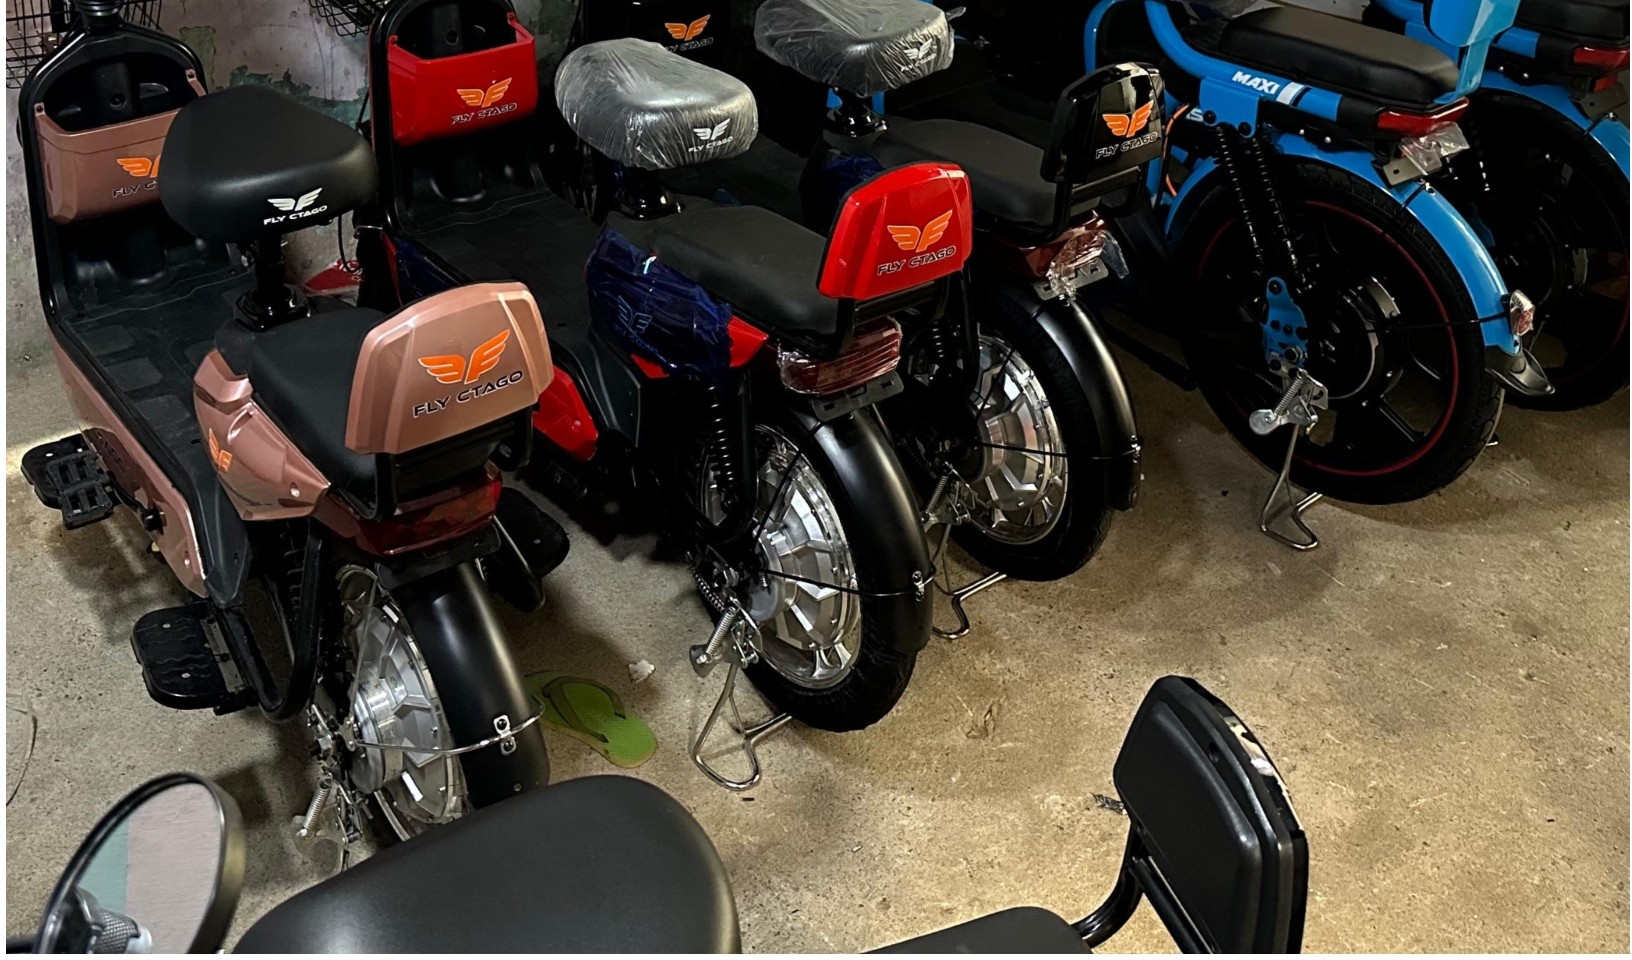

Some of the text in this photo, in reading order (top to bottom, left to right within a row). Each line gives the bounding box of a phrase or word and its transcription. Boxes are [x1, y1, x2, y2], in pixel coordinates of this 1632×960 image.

[1232, 71, 1280, 94] MAXI
[451, 113, 475, 125] FLY
[1096, 143, 1119, 159] FLY
[112, 184, 140, 198] FLY
[264, 205, 328, 225] FLY CTAGO
[877, 259, 906, 276] FLY
[413, 370, 523, 418] FLY CTAGO
